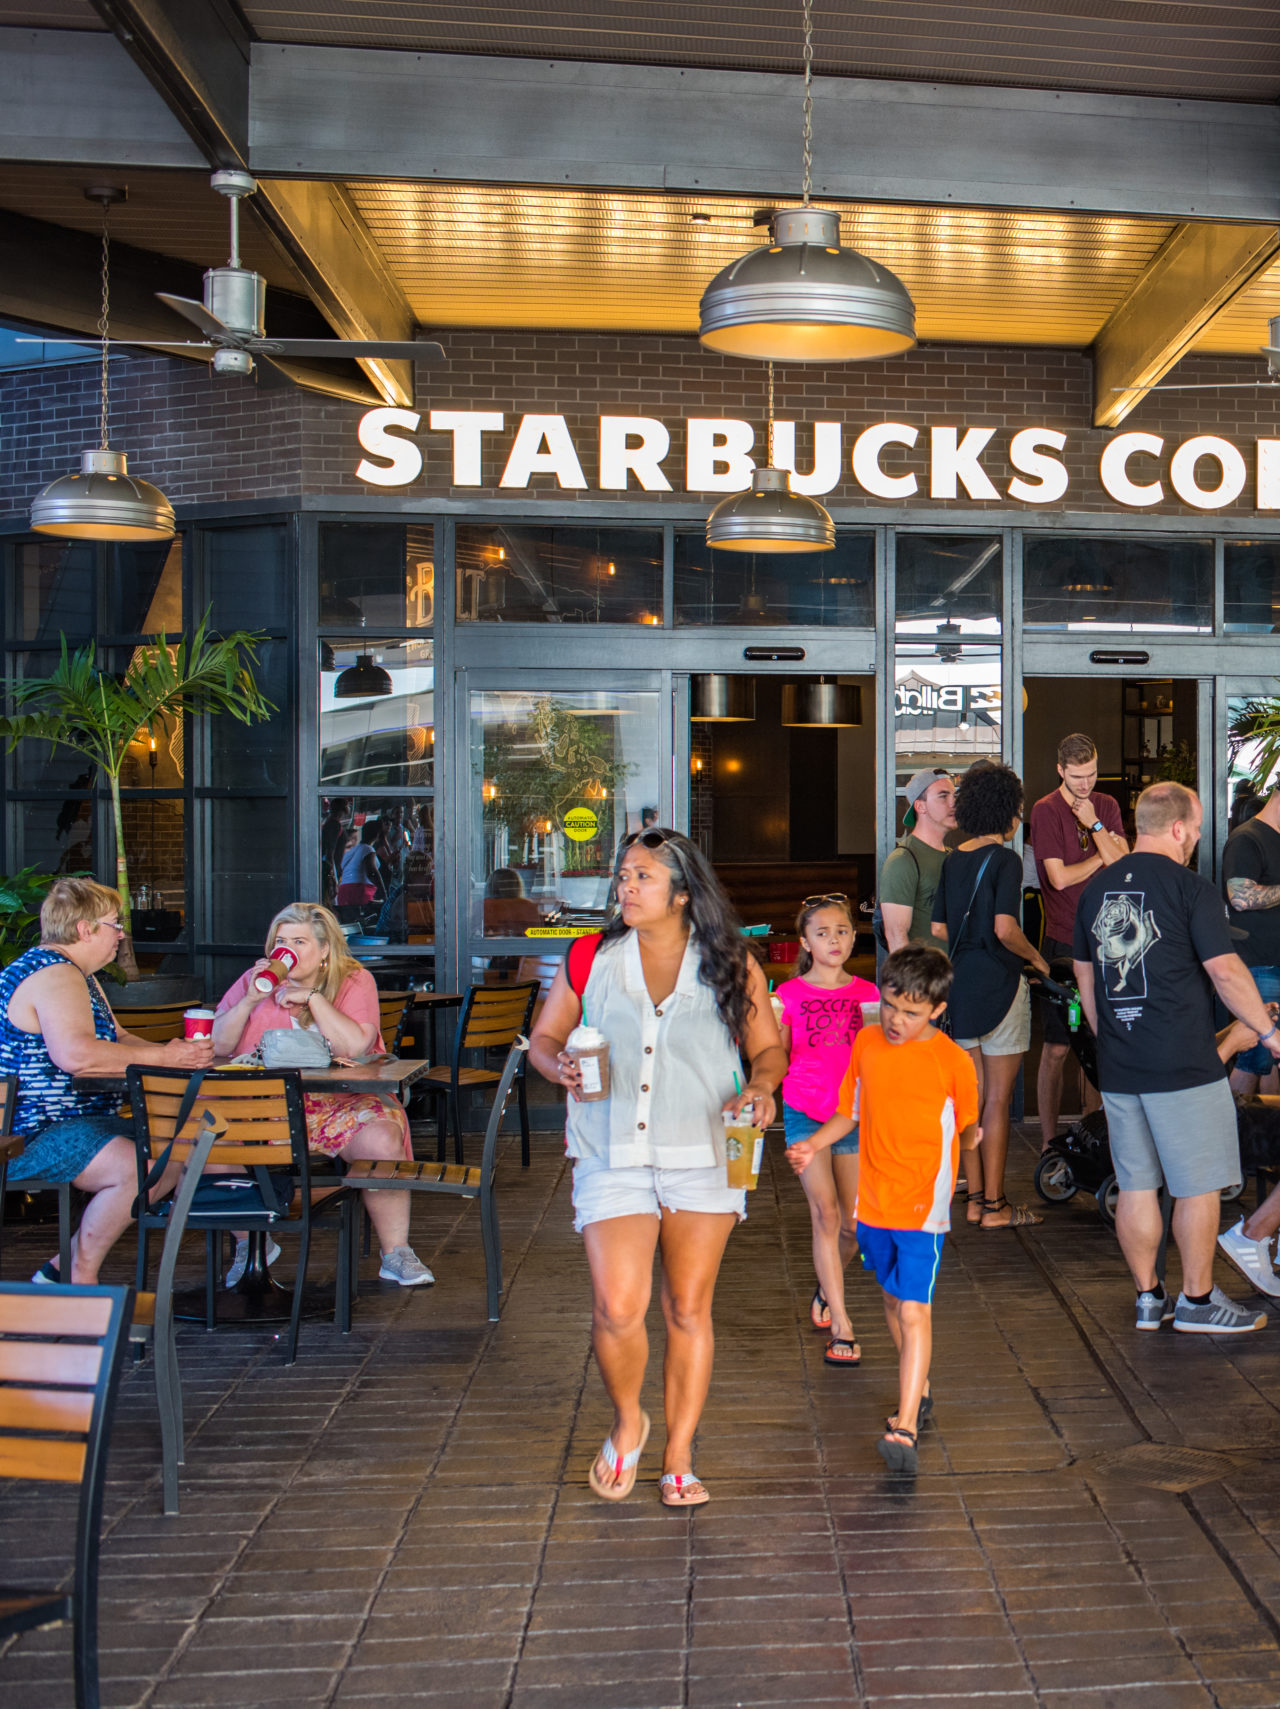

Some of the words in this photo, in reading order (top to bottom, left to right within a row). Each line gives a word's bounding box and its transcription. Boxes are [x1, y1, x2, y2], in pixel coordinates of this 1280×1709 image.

[355, 407, 1069, 505] STARBUCKS
[530, 928, 558, 936] AUTOMATIC
[558, 928, 572, 936] DOOR
[800, 999, 860, 1015] SOCCER
[806, 1014, 860, 1031] LOVE
